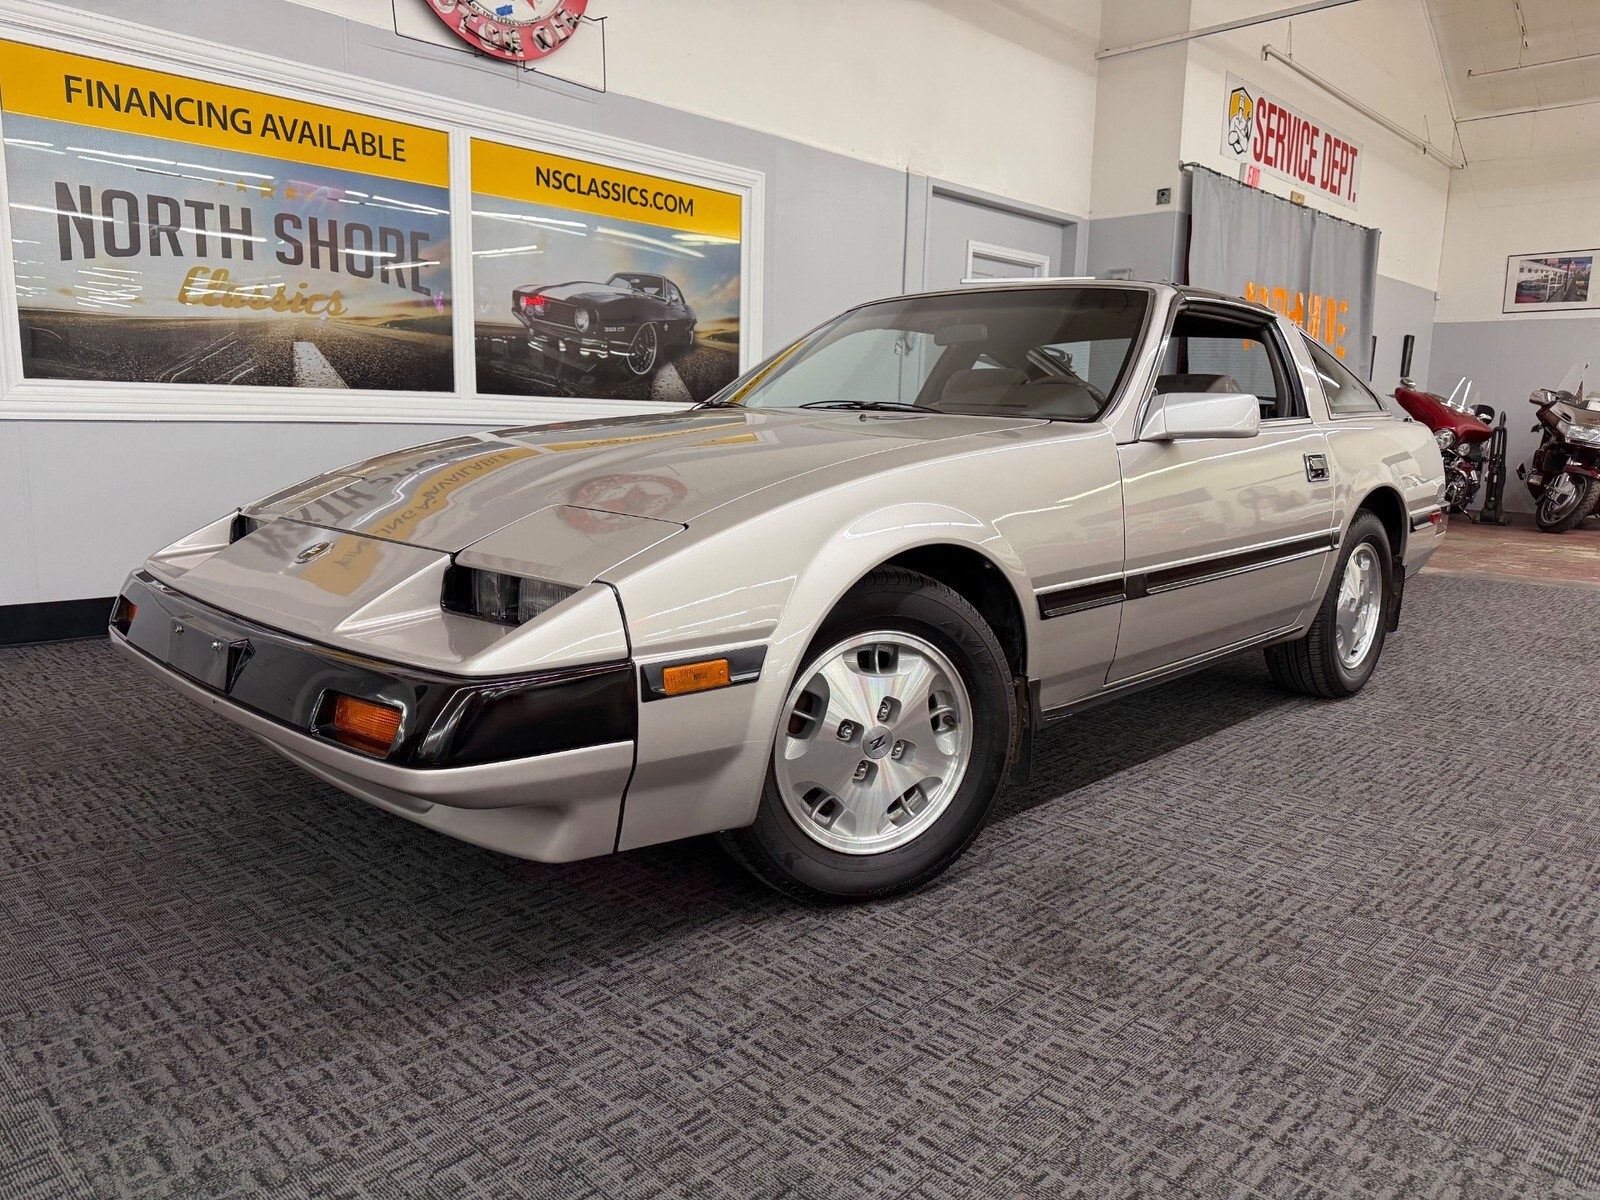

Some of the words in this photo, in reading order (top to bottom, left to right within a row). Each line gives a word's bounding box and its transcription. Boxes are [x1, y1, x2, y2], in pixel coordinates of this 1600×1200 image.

[64, 74, 252, 135] FINANCING
[260, 113, 406, 163] AVAILABLE
[1253, 96, 1320, 185] SERVICE
[1320, 132, 1358, 203] DEPT.
[535, 166, 694, 217] NSCLASSICS.COM
[55, 181, 254, 261] NORTH
[274, 212, 431, 296] SHORE
[178, 265, 349, 316] Classics
